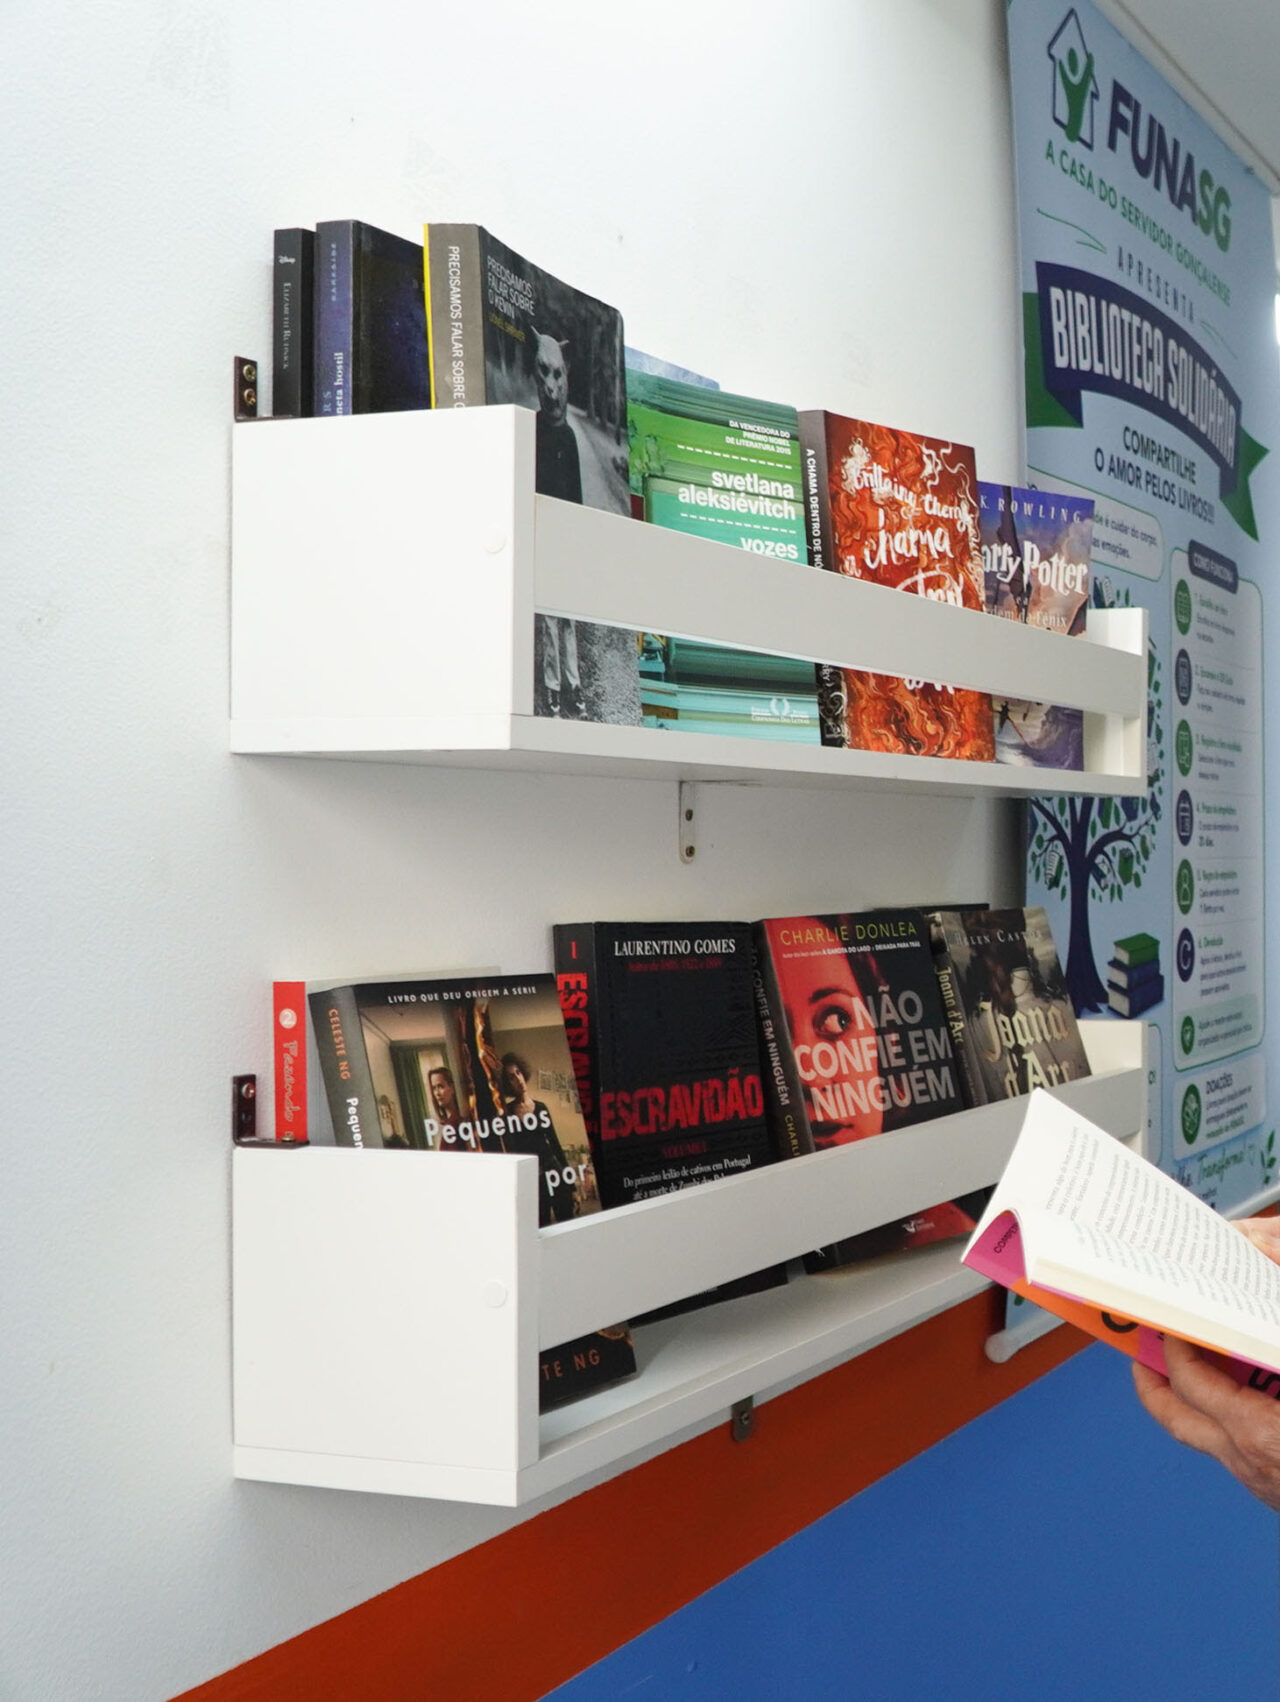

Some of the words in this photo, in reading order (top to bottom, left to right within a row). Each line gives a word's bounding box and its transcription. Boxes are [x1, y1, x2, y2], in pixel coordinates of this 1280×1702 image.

[1107, 79, 1231, 252] FUNASG
[1045, 139, 1055, 165] A
[1059, 150, 1095, 190] CASA
[1099, 178, 1118, 210] DO
[1121, 196, 1174, 257] SERVIDOR
[448, 246, 462, 319] PRECISAMOS
[487, 256, 533, 297] PRECISAMOS
[488, 272, 509, 300] FALAR
[509, 287, 535, 316] SOBRE
[1117, 247, 1195, 323] APRESENTA
[495, 294, 515, 320] KEVIN
[451, 322, 464, 358] FALAR
[1049, 286, 1165, 401] BIBLIOTECA
[333, 352, 344, 386] hostil
[452, 361, 466, 399] SOBRE
[780, 430, 790, 439] DO
[807, 448, 815, 456] A
[1123, 425, 1196, 485] COMPARTILHE
[711, 471, 795, 499] svetlana
[807, 457, 817, 496] CHAMA
[1094, 447, 1105, 472] O
[1107, 455, 1142, 489] AMOR
[1145, 470, 1176, 505] PELOS
[678, 484, 796, 520] aleksiévitch
[809, 497, 821, 537] DENTRO
[997, 501, 1083, 523] ROWLING
[740, 537, 798, 559] vozes
[813, 538, 822, 552] DE
[981, 543, 1021, 583] arry
[1023, 540, 1089, 595] Potter
[614, 940, 691, 957] LAURENTINO
[694, 938, 736, 955] GOMES
[780, 925, 849, 946] CHARLIE
[855, 921, 917, 941] DONLEA
[388, 993, 417, 1004] LIVRO
[420, 992, 440, 1002] QUE
[443, 990, 462, 1001] DEU
[465, 988, 500, 999] ORIGEM
[512, 985, 537, 996] SÉRIE
[753, 969, 770, 1019] CONFIE
[851, 985, 924, 1031] NÃO
[936, 967, 956, 1009] Joana
[328, 1008, 347, 1056] CELESTE
[339, 1061, 351, 1080] NG
[762, 1019, 775, 1042] EM
[979, 1000, 1069, 1062] Joana
[768, 1041, 790, 1106] NINGUÉM
[793, 1032, 906, 1081] CONFIE
[909, 1026, 953, 1064] EM
[600, 1067, 764, 1141] ESCRAVIDÃO
[811, 1064, 956, 1122] NINGUÉM
[424, 1109, 552, 1149] Pequenos
[545, 1163, 588, 1196] por
[623, 1176, 634, 1189] Do
[634, 1170, 661, 1189] primeiro
[680, 1165, 690, 1179] de
[712, 1161, 723, 1172] em
[723, 1154, 752, 1172] Portugal
[574, 1348, 602, 1371] NG
